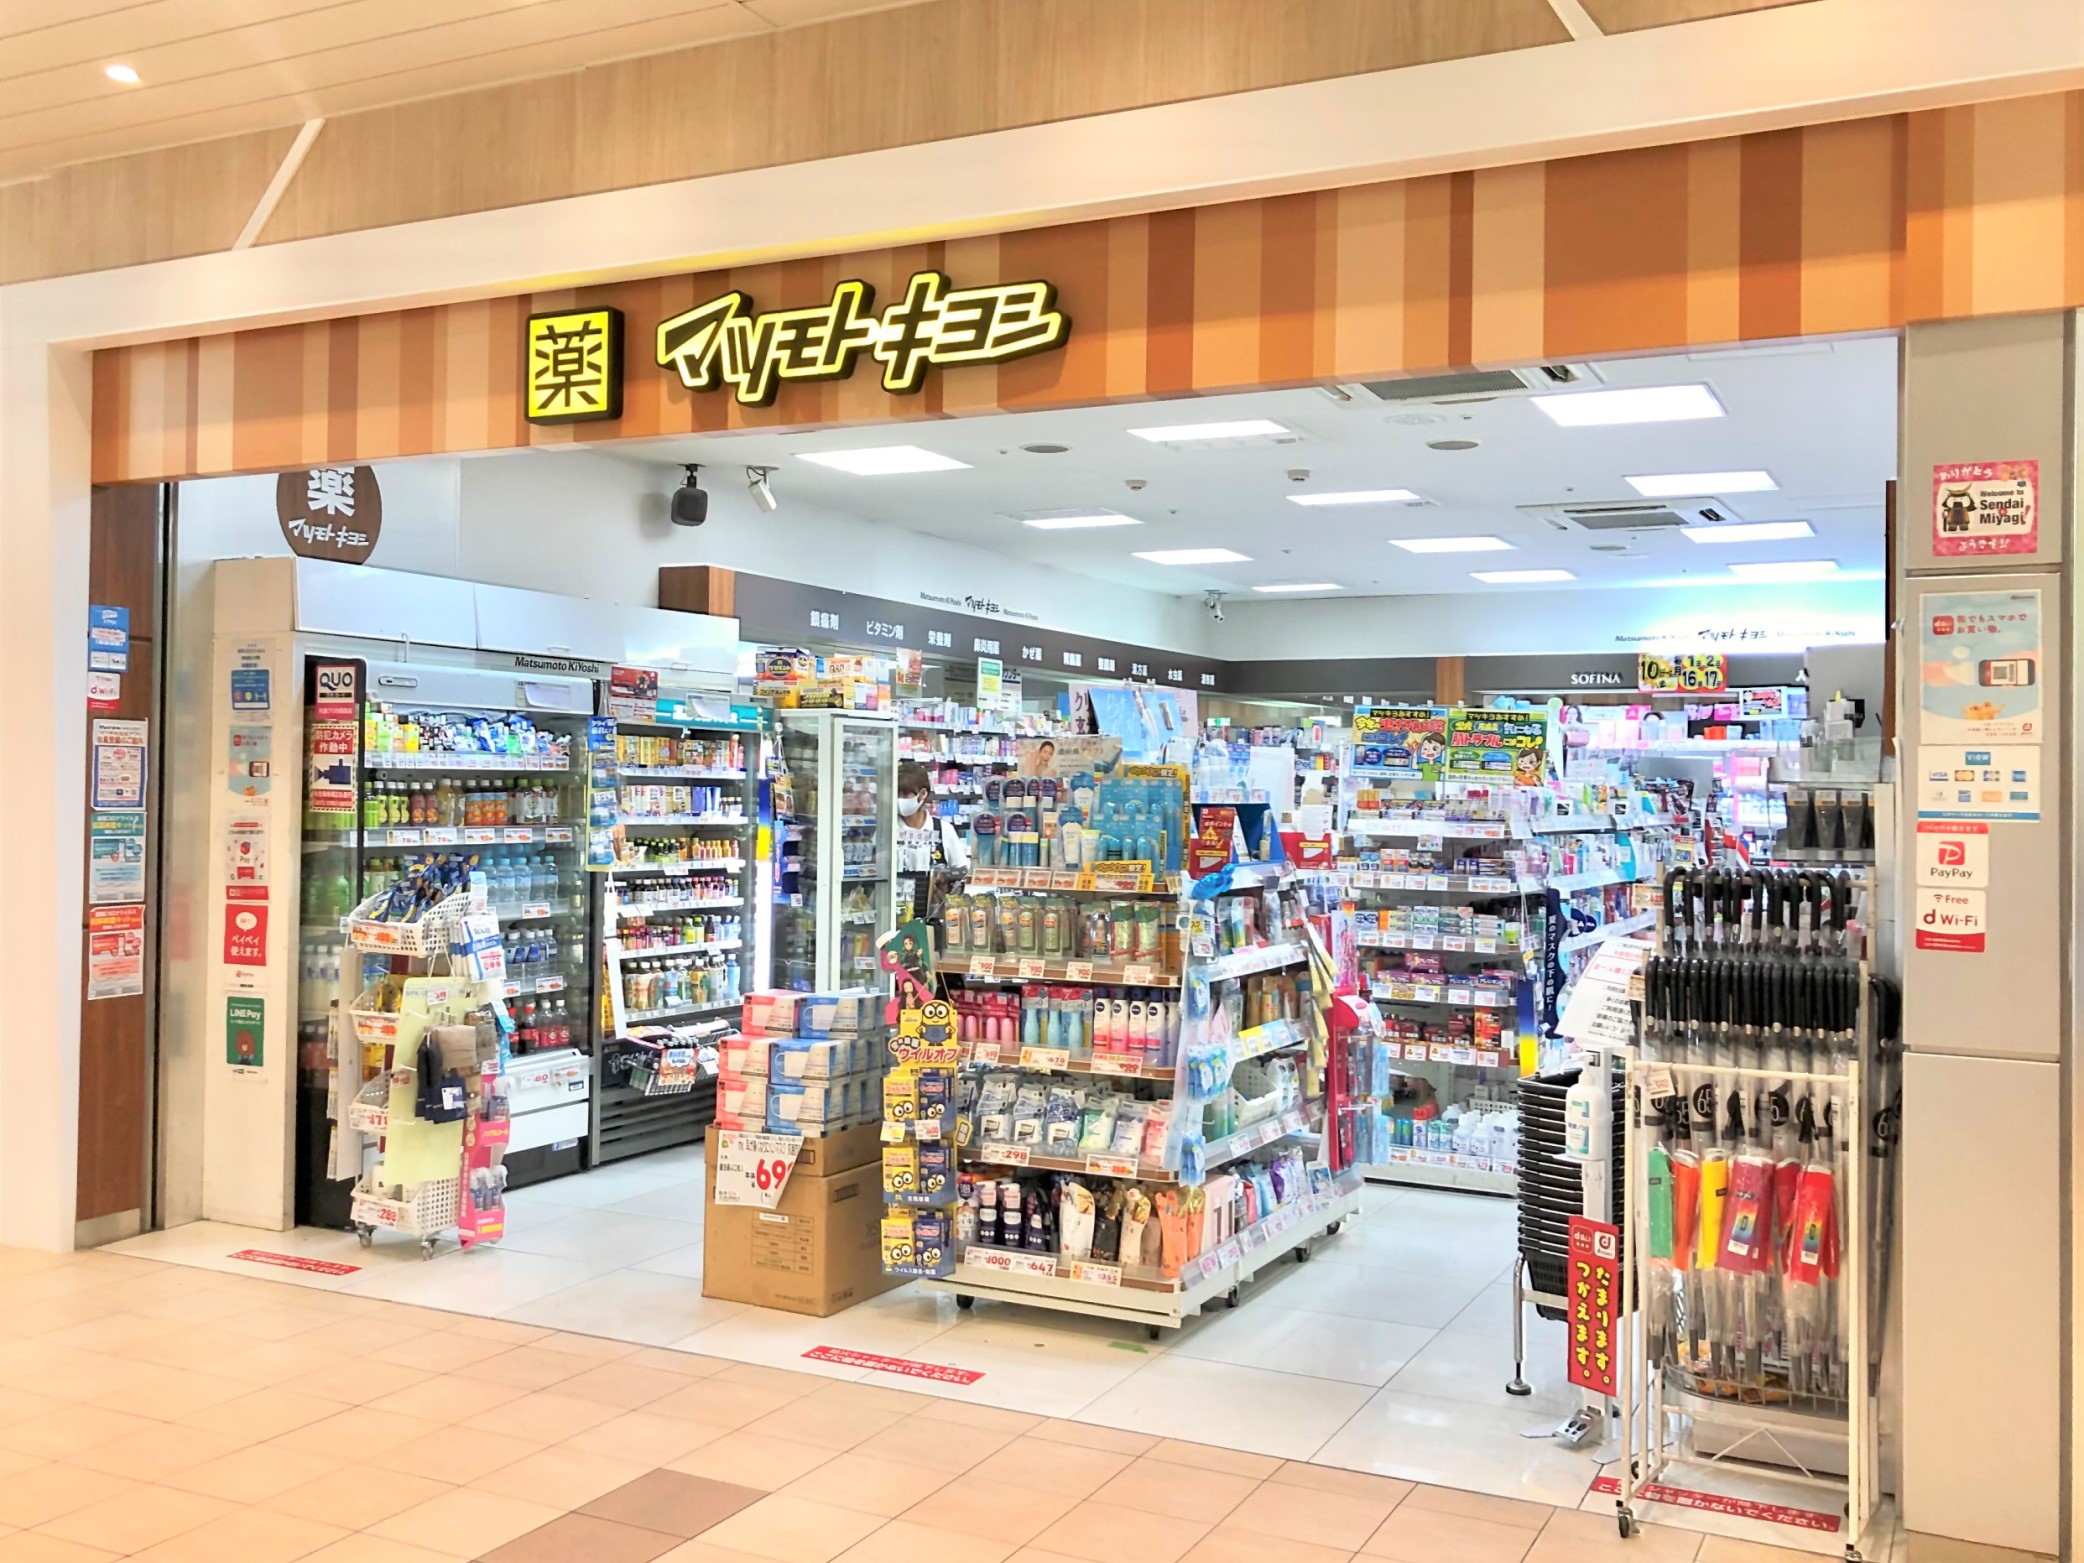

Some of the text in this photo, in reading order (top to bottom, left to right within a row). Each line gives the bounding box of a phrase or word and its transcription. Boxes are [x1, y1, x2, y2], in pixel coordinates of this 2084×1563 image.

[657, 271, 1067, 403] マツモトキヨシ
[534, 318, 603, 411] 薬
[1938, 466, 1993, 481] ありがとう
[1980, 488, 2025, 498] Welcome to
[1980, 497, 2024, 510] Sendai
[288, 518, 370, 549] マツモトキヨシ
[515, 656, 600, 673] Matsumoto KiYoshi
[319, 672, 353, 691] QUO
[1571, 673, 1621, 684] SOFINA
[315, 731, 353, 742] 防犯カメラ
[319, 742, 348, 753] 作動中
[1930, 867, 1973, 879] PayPay
[1945, 895, 1969, 904] Free
[1923, 908, 1978, 926] d Wi-Fi
[229, 1008, 261, 1020] LINE Pay
[899, 1048, 958, 1061] ウイルオフ
[757, 1158, 794, 1191] 69
[1575, 1261, 1591, 1378] つかえます。
[1595, 1265, 1611, 1385] たまります。
